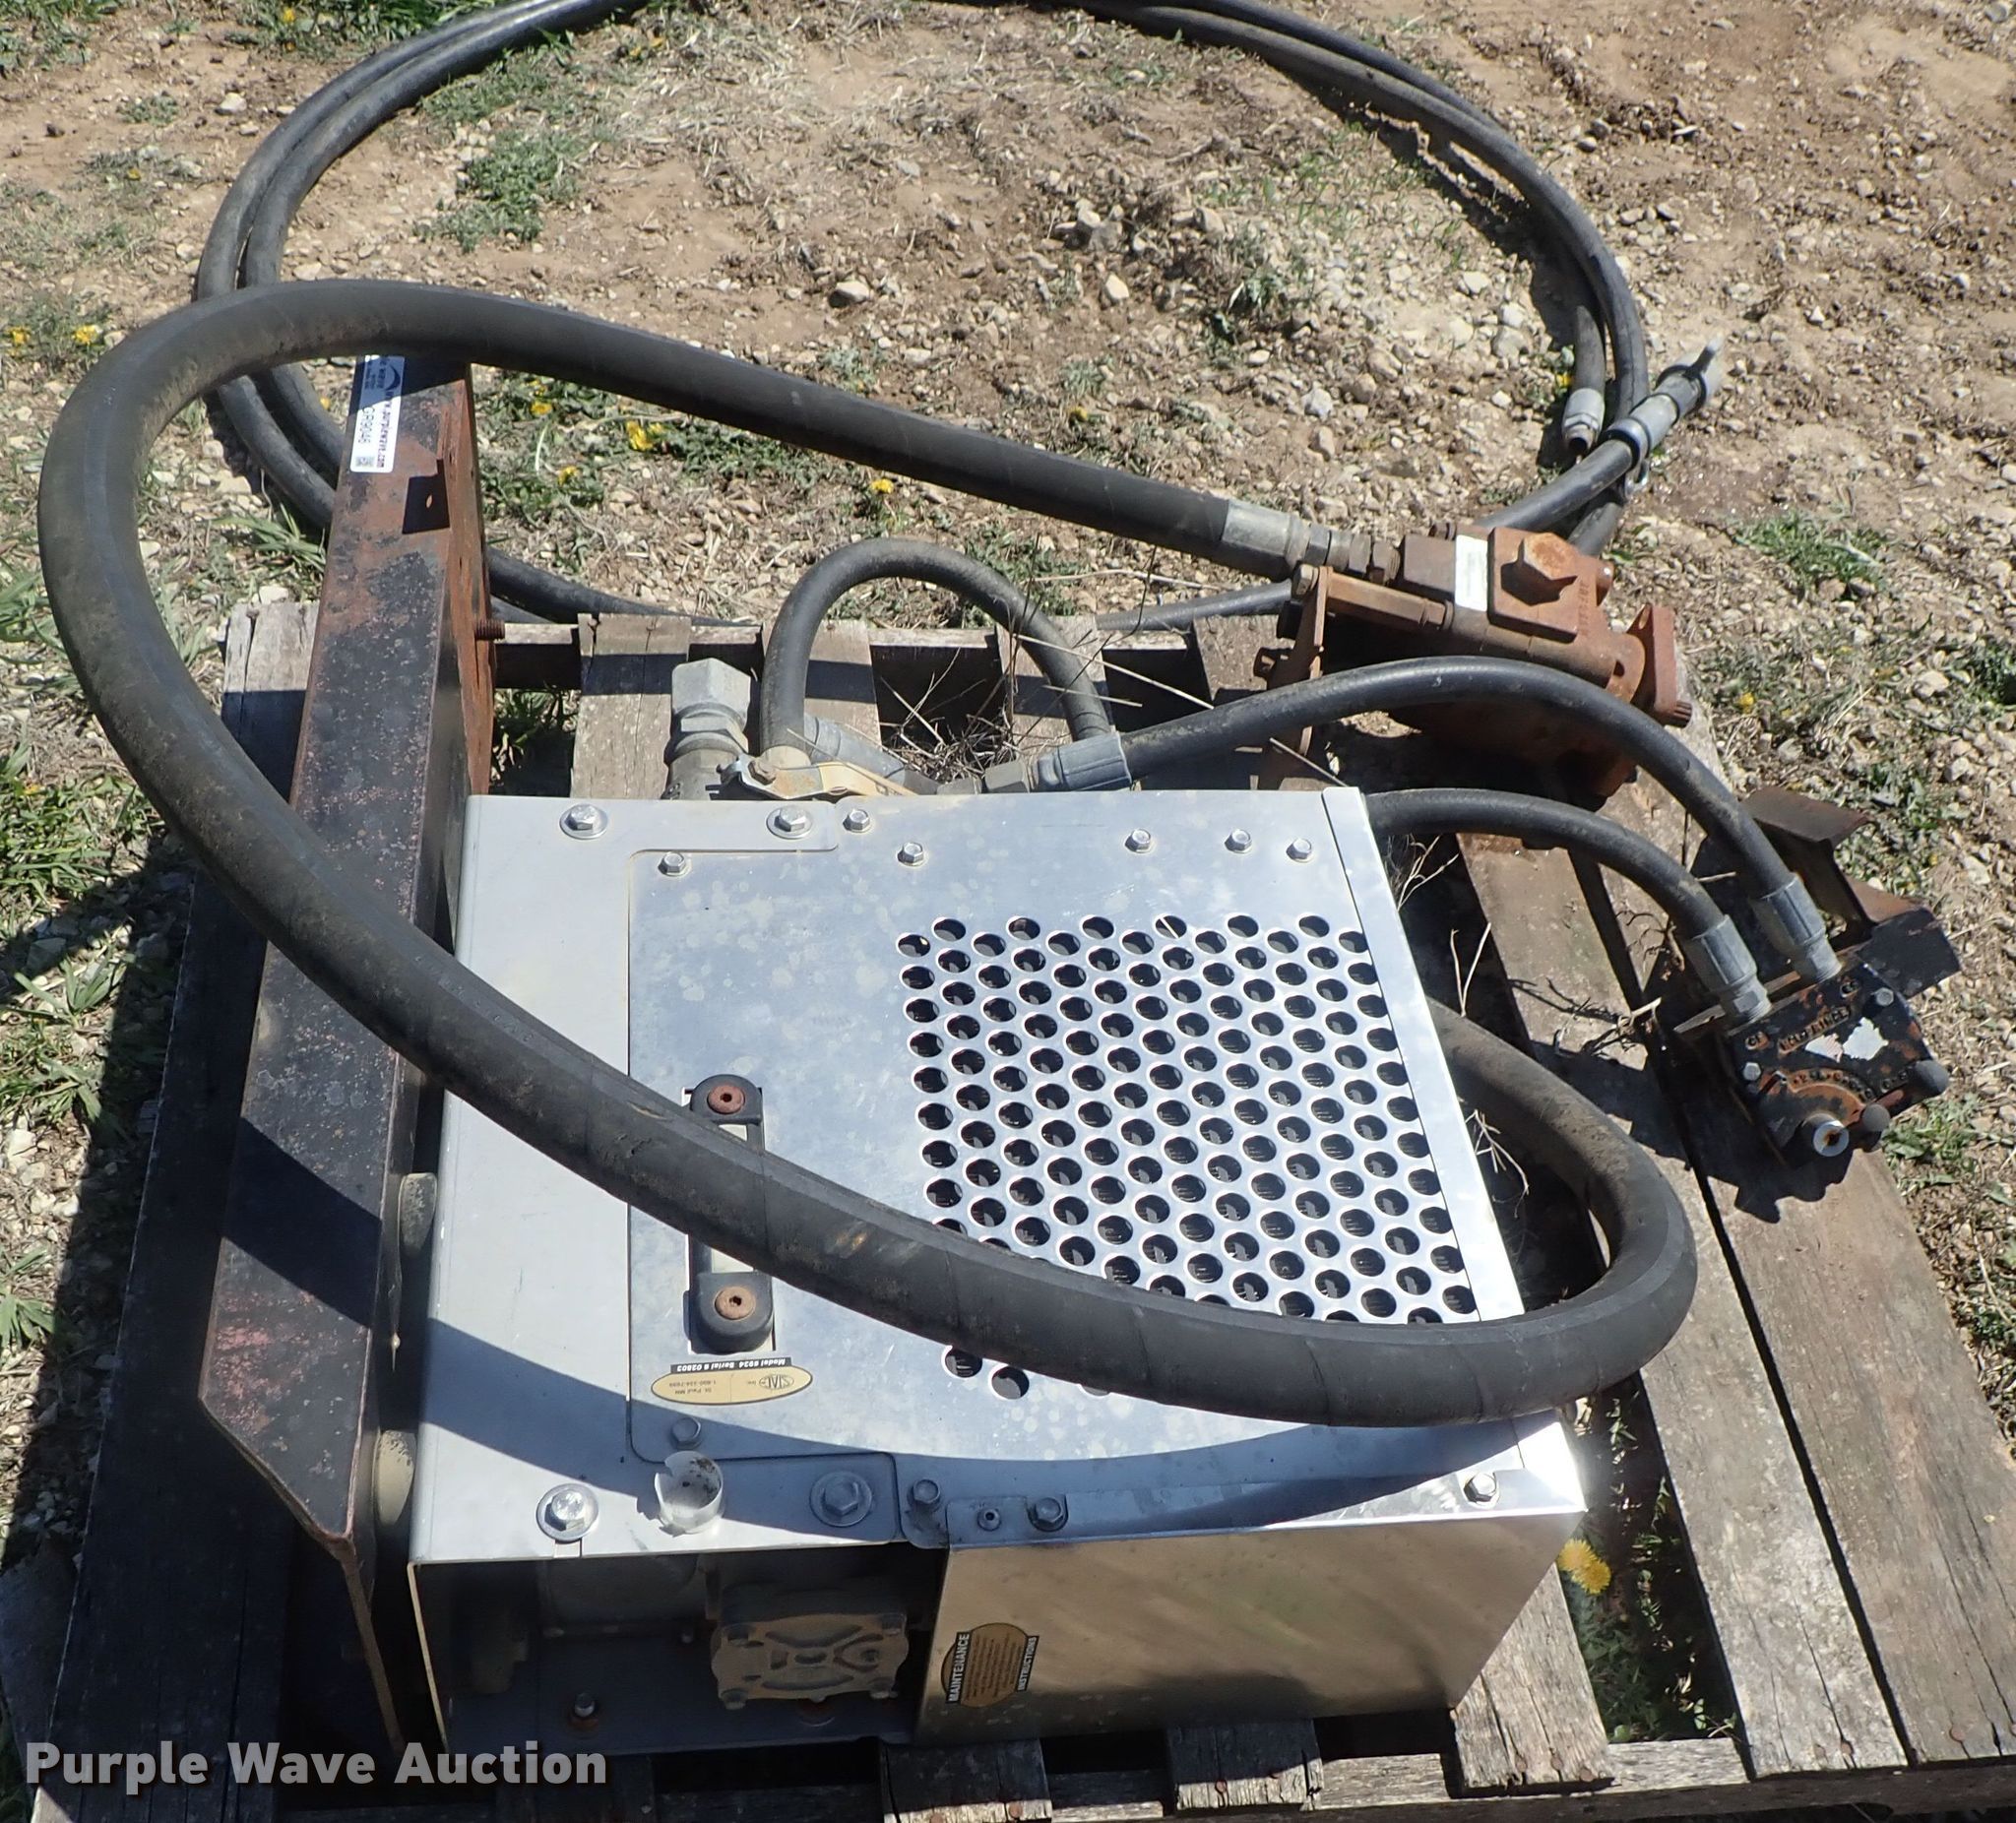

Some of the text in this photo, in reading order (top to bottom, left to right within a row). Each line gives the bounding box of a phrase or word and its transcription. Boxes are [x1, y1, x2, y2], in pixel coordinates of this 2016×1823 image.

[711, 1361, 734, 1370] Serial
[948, 1634, 970, 1701] MAINTENANCE
[1017, 1637, 1037, 1691] INSTRUCTIONS
